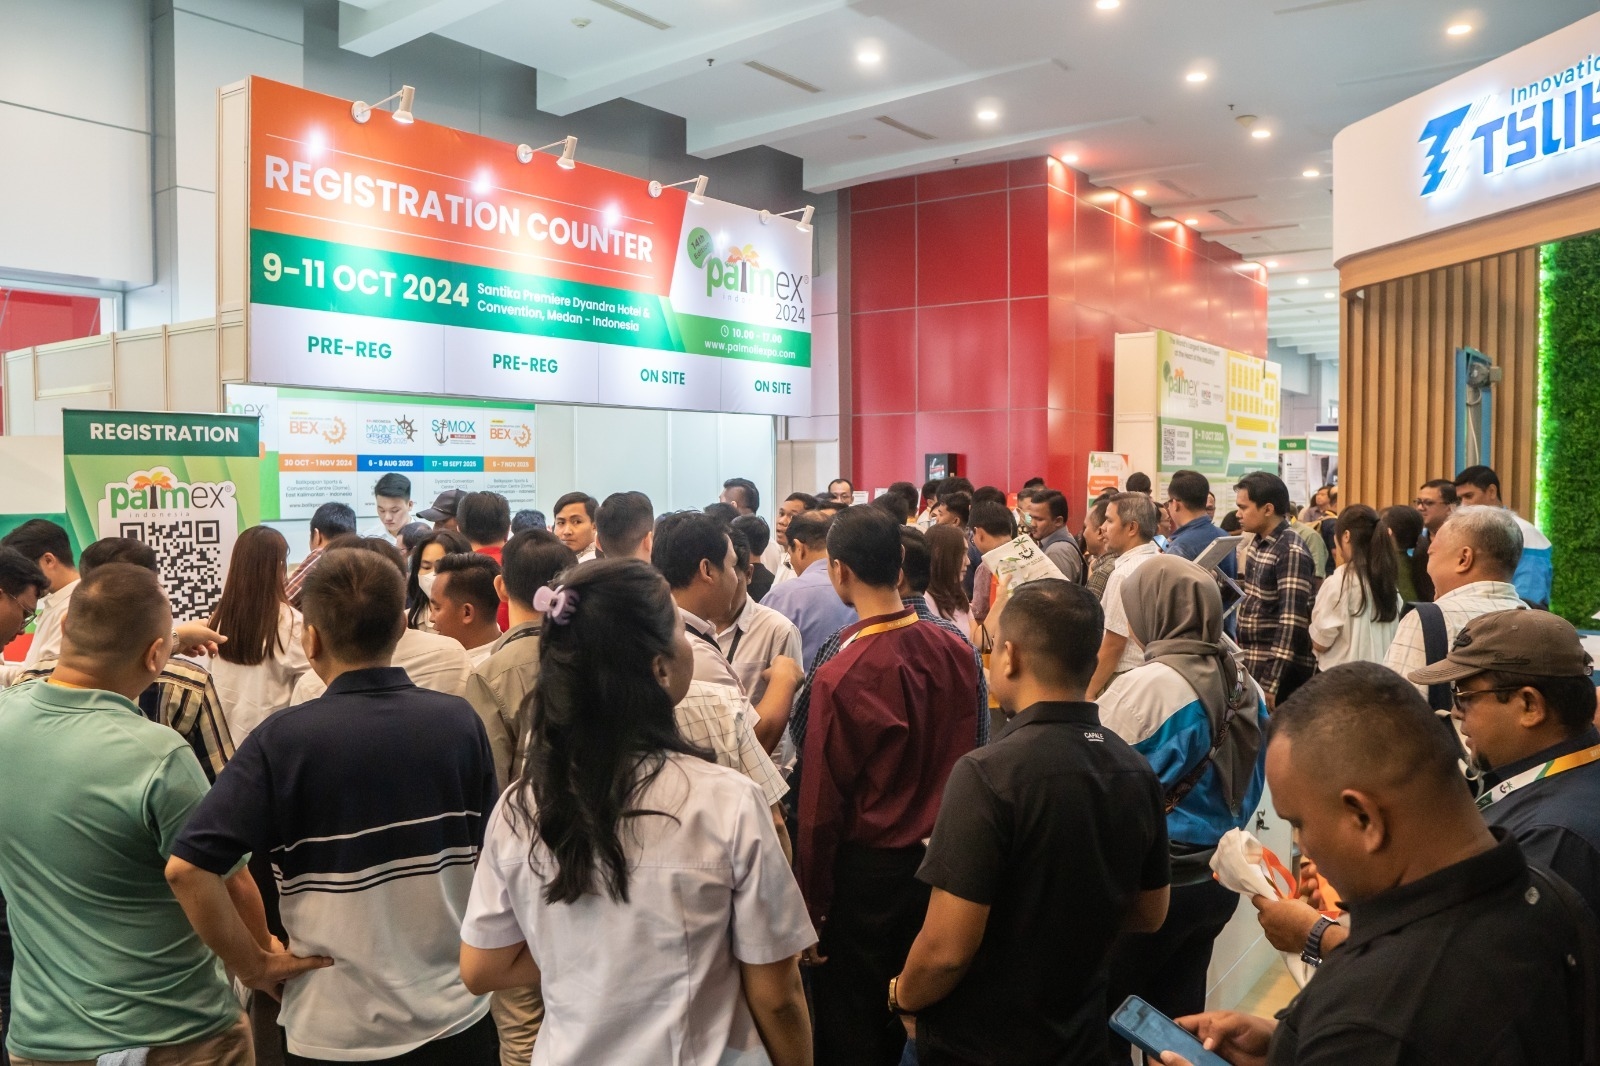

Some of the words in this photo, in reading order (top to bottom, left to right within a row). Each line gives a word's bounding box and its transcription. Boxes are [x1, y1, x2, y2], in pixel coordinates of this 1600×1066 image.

[265, 154, 520, 237] REGISTRATION
[526, 212, 653, 263] COUNTER
[332, 265, 397, 298] OCT
[402, 274, 470, 308] 2024
[477, 282, 522, 300] Santika
[522, 288, 571, 306] Premiere
[572, 294, 616, 313] Dyandra
[617, 303, 640, 318] Hotel
[641, 307, 650, 319] &
[477, 300, 545, 321] Convention,
[548, 309, 582, 324] Medan
[592, 316, 640, 332] Indonesia
[776, 303, 806, 324] 2024
[732, 328, 754, 340] 10.00
[762, 332, 782, 344] 17.00
[308, 336, 392, 359] PRE-REG
[704, 340, 796, 359] www.palmoilexpo.com
[492, 354, 558, 374] PRE-REG
[640, 368, 659, 383] ON
[662, 370, 686, 385] SITE
[754, 380, 770, 393] ON
[772, 382, 792, 394] SITE
[90, 422, 239, 443] REGISTRATION
[290, 420, 318, 434] BEX
[366, 424, 396, 434] MARINE
[490, 428, 511, 440] BEX
[110, 485, 225, 518] palmex
